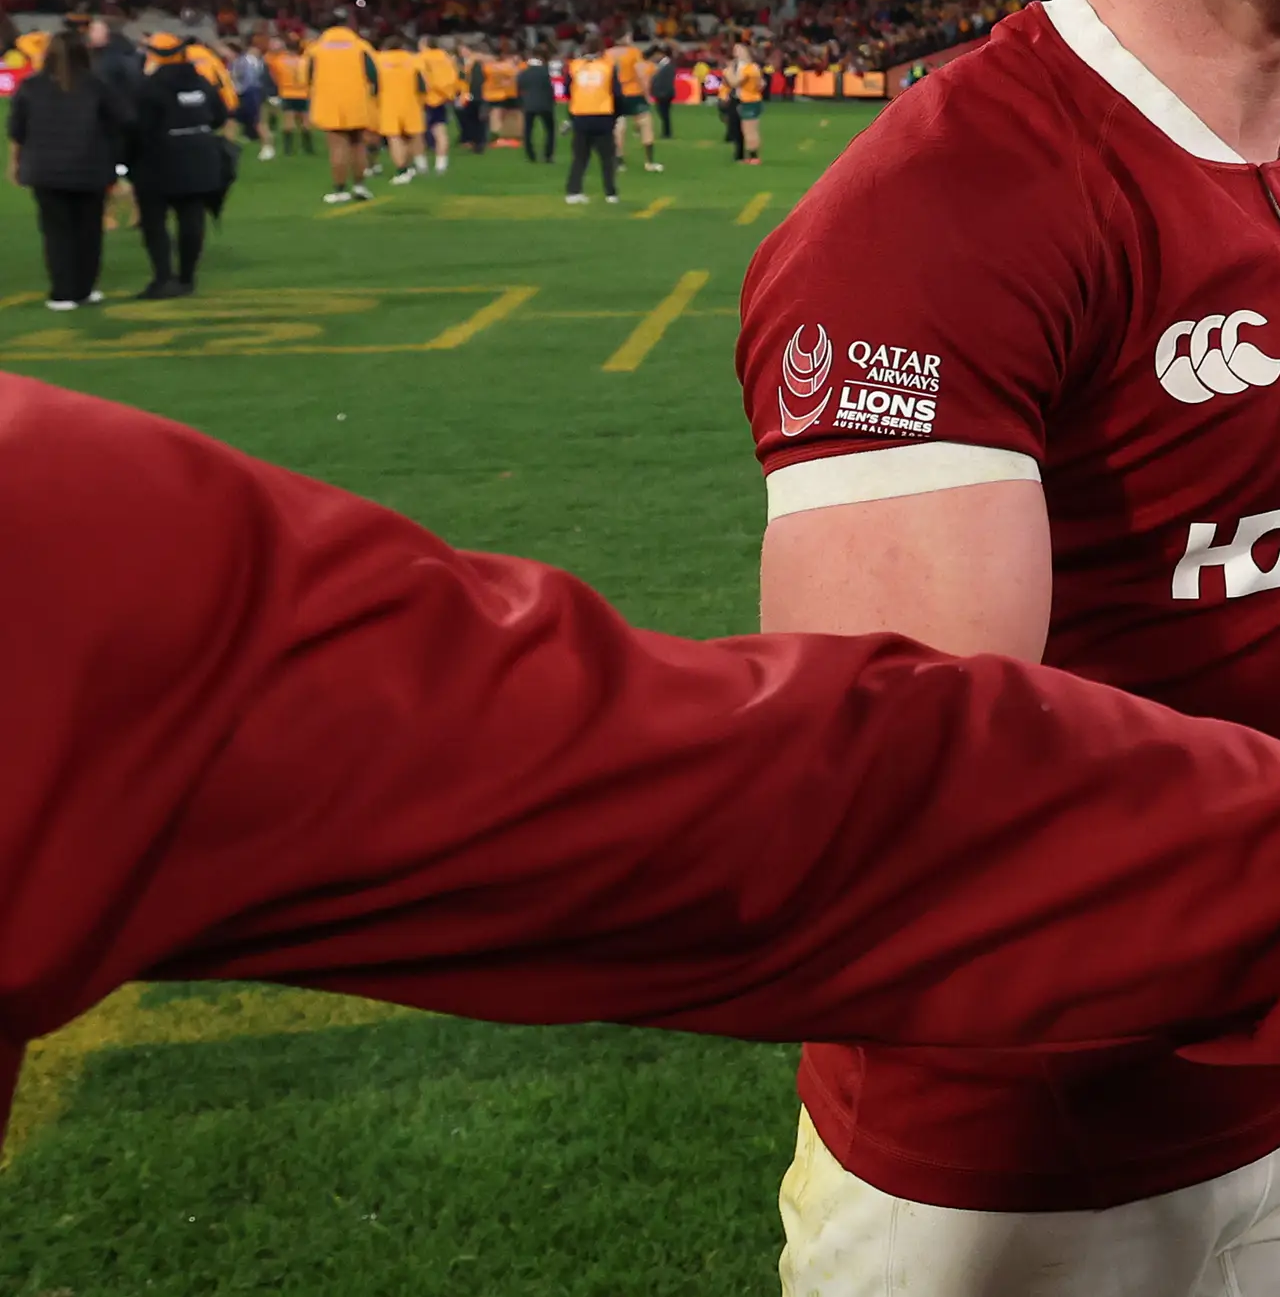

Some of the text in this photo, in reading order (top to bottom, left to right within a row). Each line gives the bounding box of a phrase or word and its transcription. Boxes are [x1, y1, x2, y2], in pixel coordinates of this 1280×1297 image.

[848, 341, 941, 378] QATAR
[866, 367, 939, 392] AIRWAYS
[839, 386, 937, 422] LIONS
[832, 420, 896, 436] AUSTRALIA
[836, 409, 932, 433] MEN'S SERIES
